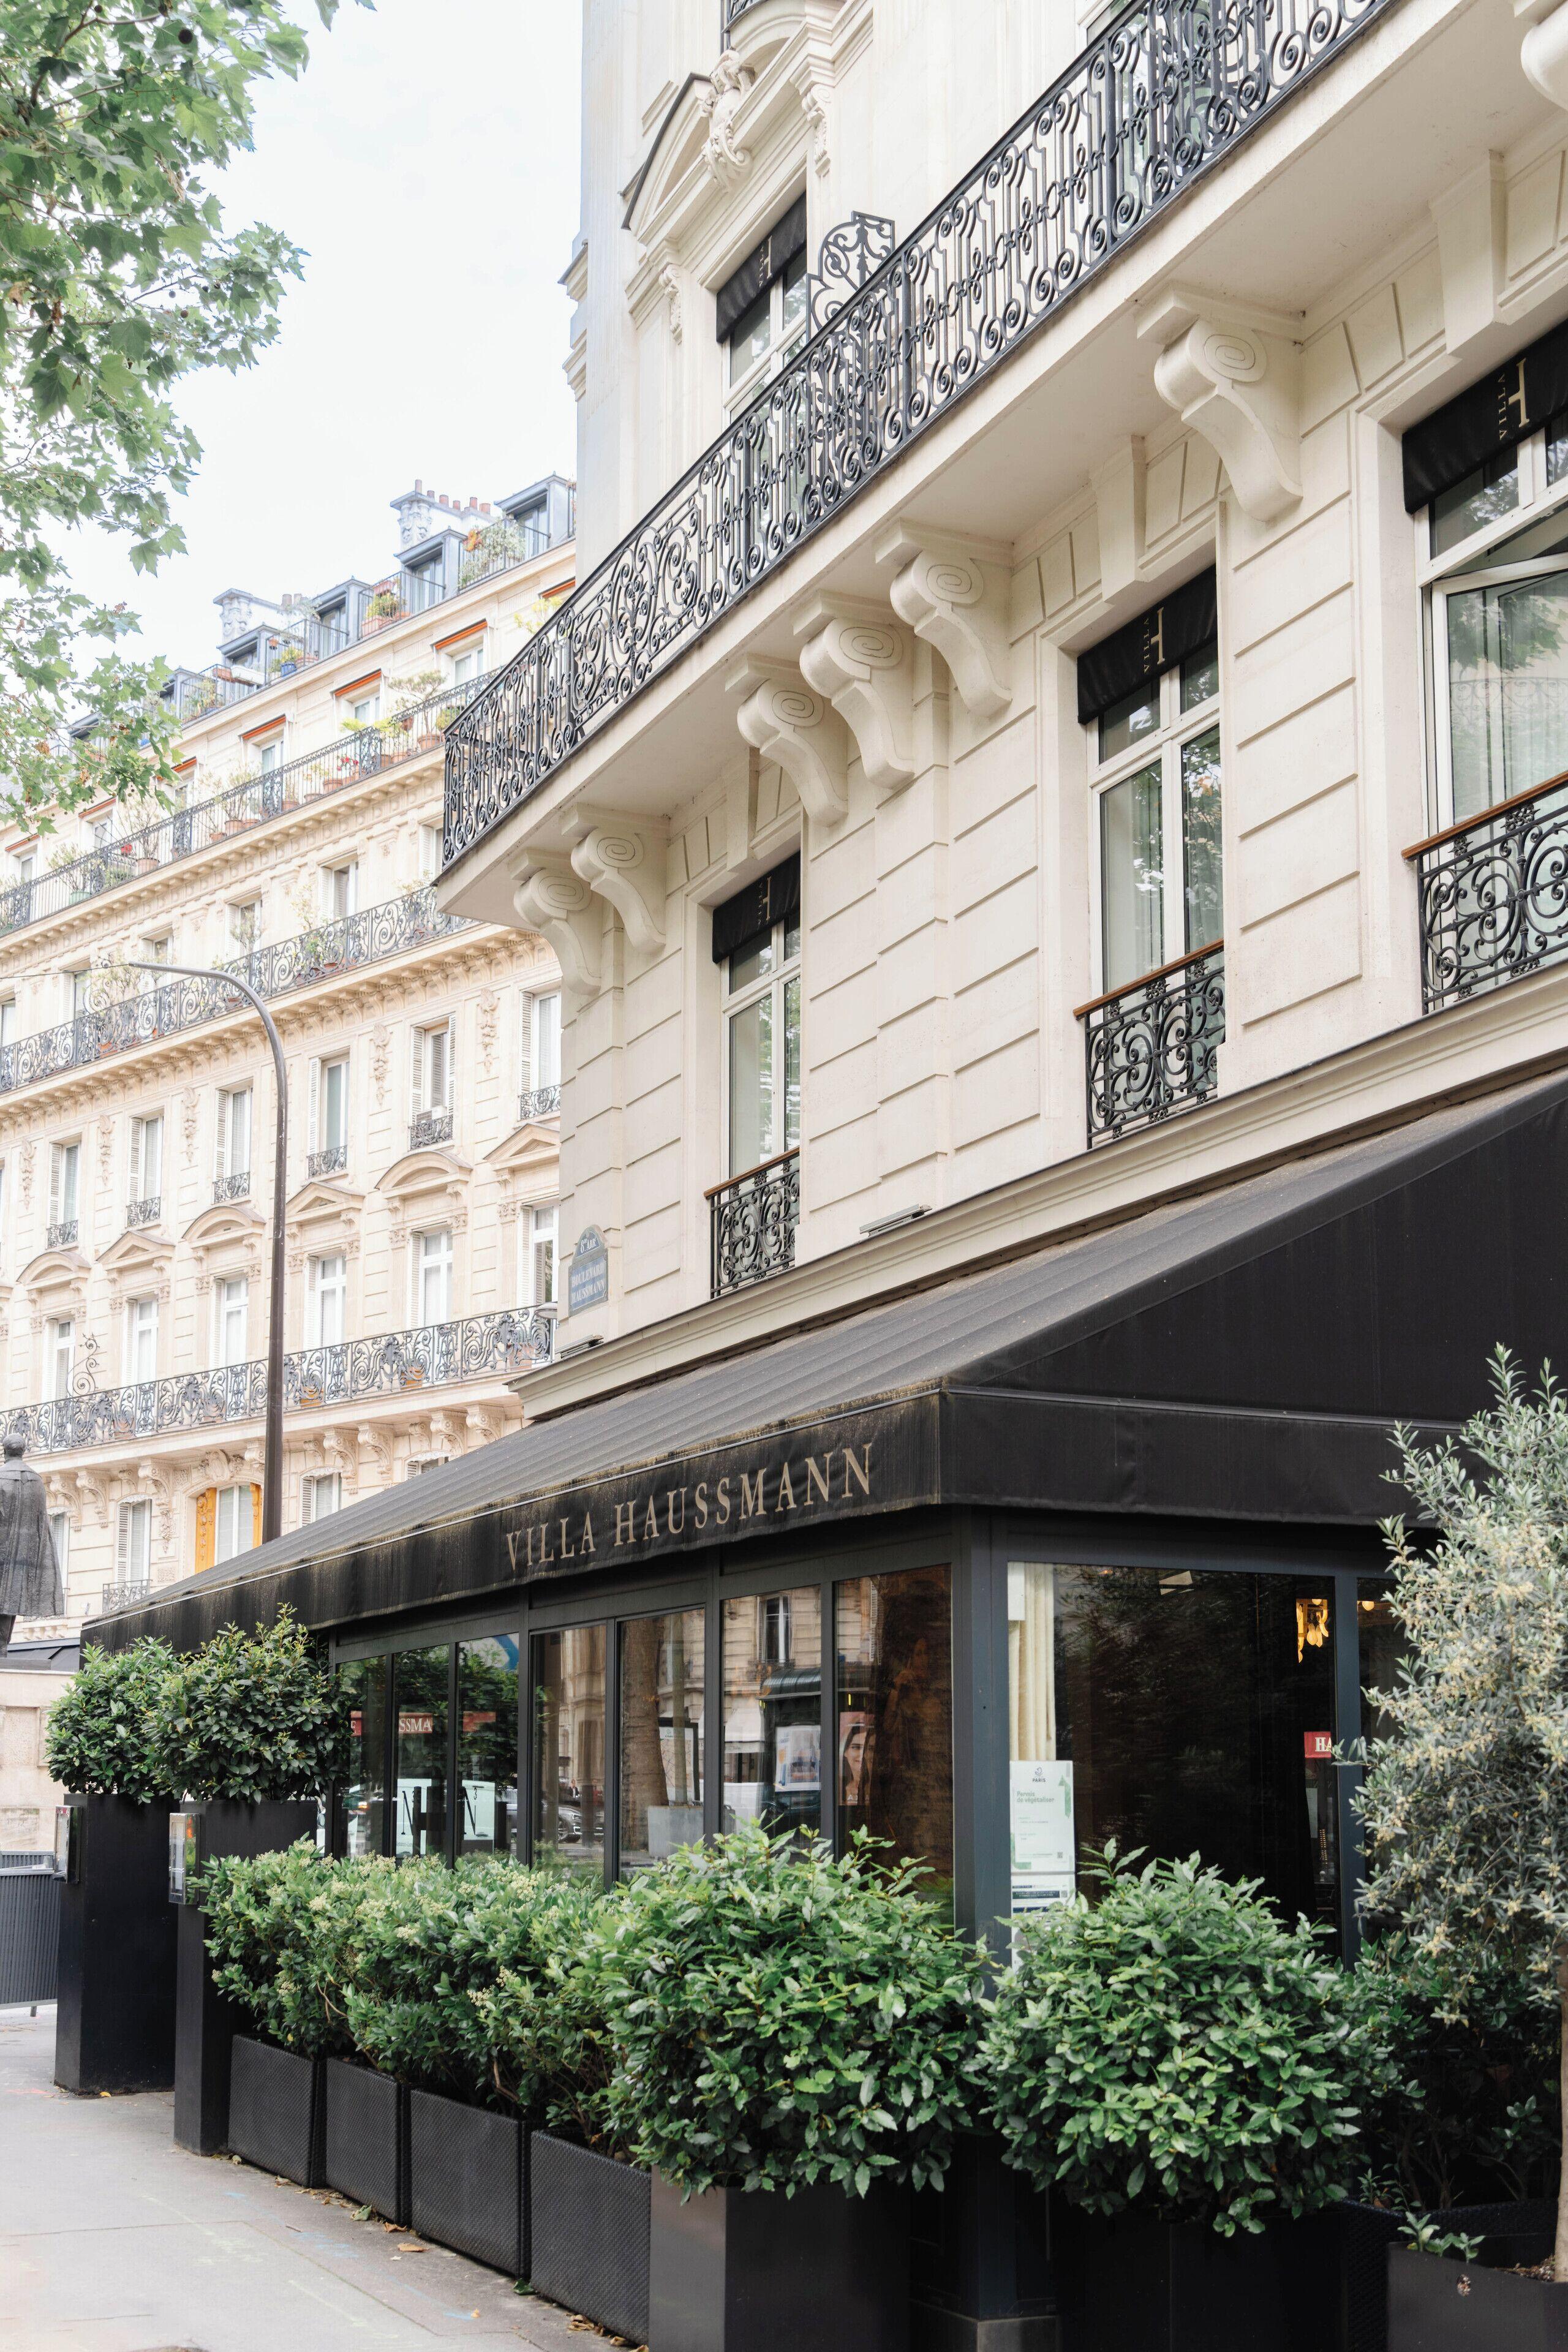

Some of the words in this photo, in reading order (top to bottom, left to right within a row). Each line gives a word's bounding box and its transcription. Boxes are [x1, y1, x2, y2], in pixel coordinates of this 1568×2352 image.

[1498, 373, 1507, 440] VILLA
[1144, 617, 1152, 674] VILLA
[572, 1262, 605, 1287] BOULEVARD
[572, 1280, 605, 1303] HAUSSMANN
[506, 1511, 597, 1571] VILLA
[613, 1442, 872, 1547] HAUSSMANN
